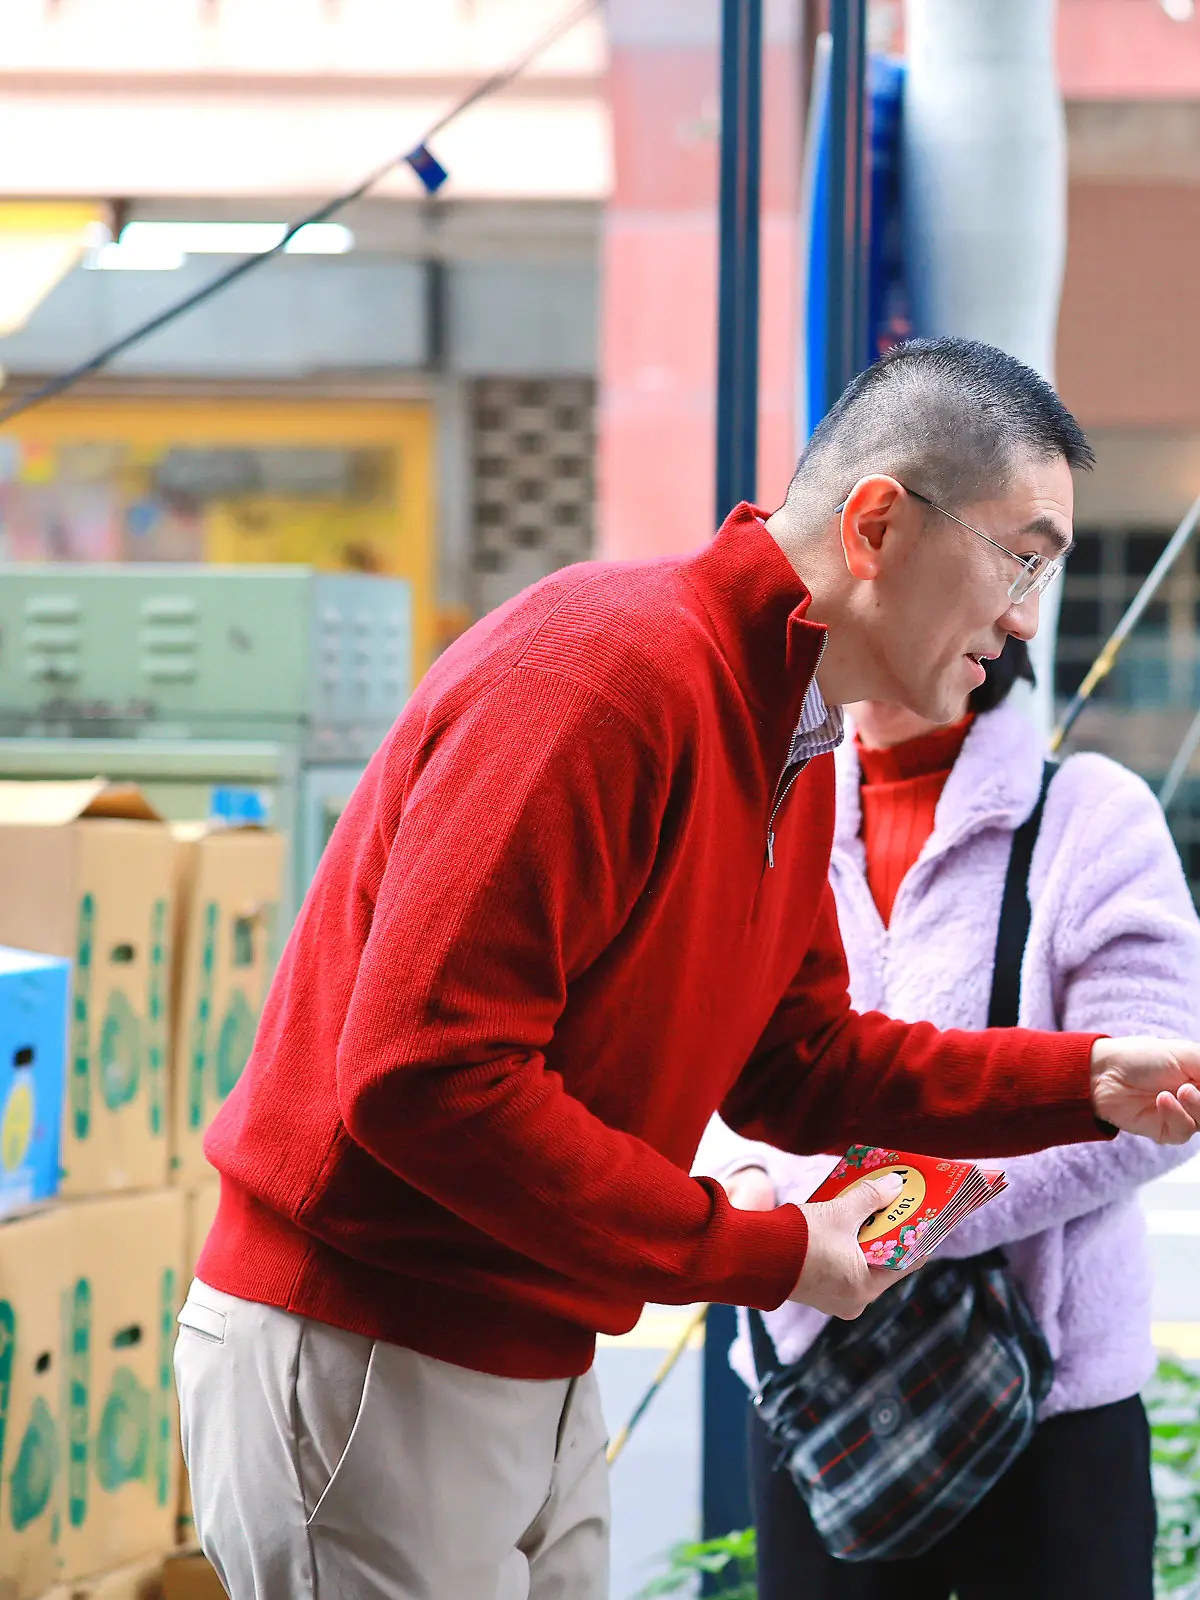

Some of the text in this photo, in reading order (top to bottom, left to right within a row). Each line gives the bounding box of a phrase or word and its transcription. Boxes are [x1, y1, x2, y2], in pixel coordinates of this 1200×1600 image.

[945, 1166, 967, 1194] KEELUNG
[948, 1164, 960, 1178] CITY
[887, 1197, 915, 1222] 2026
